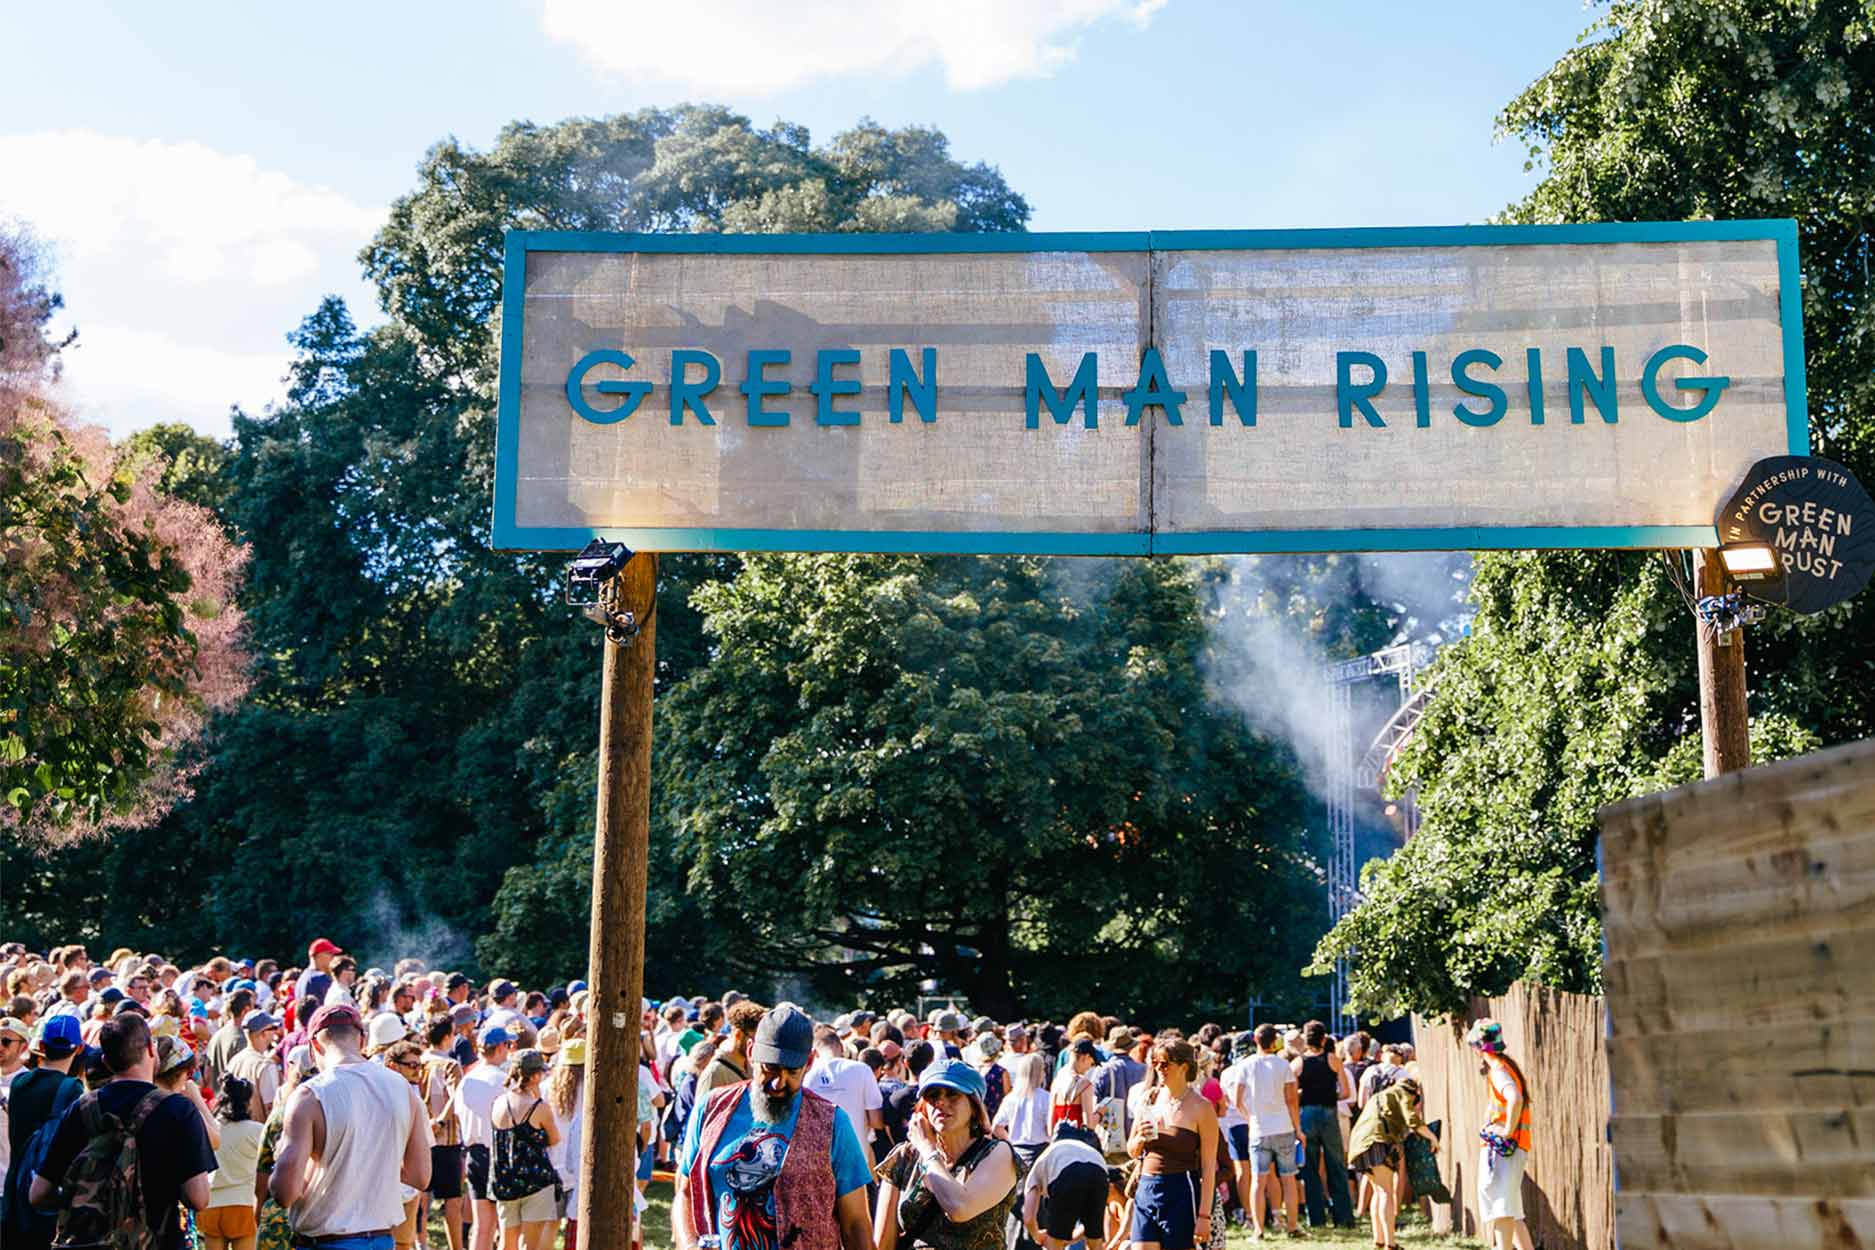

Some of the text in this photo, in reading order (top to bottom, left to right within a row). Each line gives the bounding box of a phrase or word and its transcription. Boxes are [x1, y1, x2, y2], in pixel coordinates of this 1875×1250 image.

[564, 345, 1730, 429] GREEN MAN RISING
[1729, 468, 1848, 540] IN PARTNERSHIP WITH
[1759, 502, 1852, 536] GREEN
[1775, 526, 1836, 557] MAN
[1780, 551, 1844, 580] RUST
